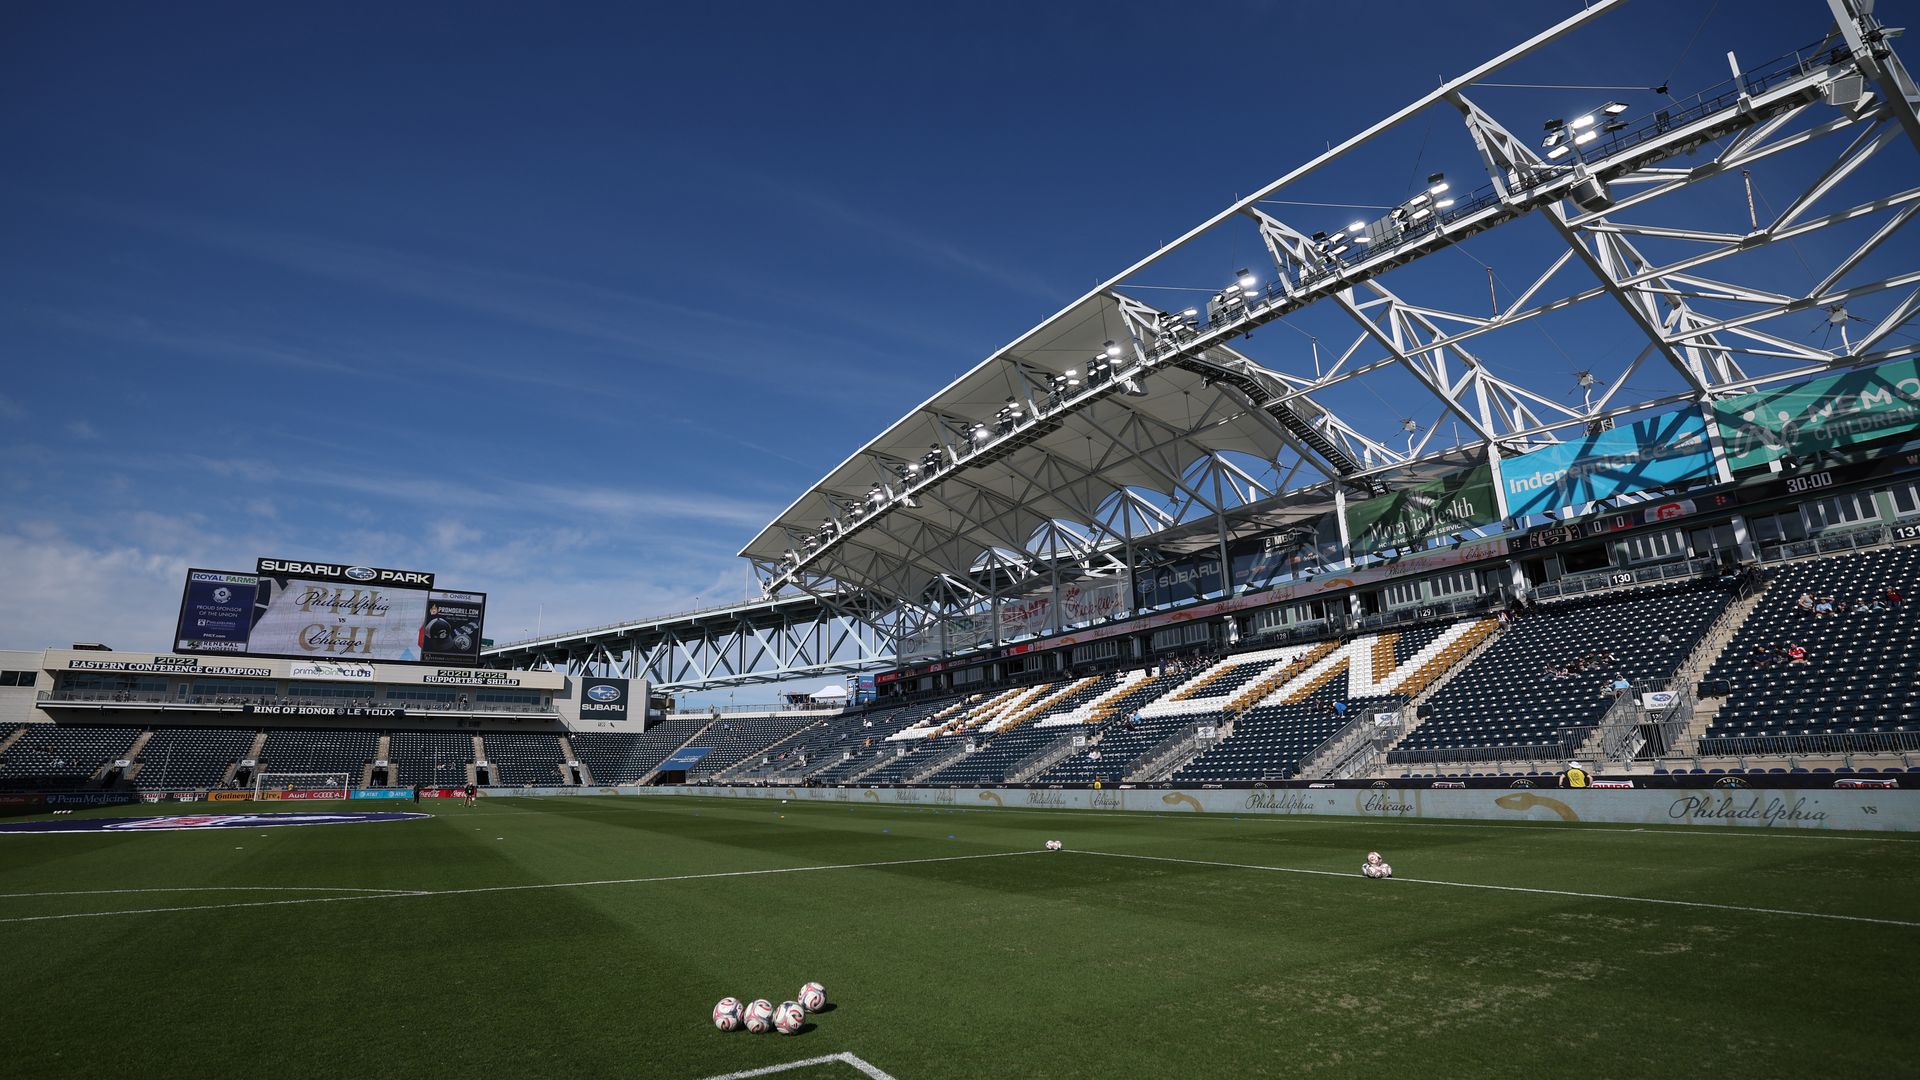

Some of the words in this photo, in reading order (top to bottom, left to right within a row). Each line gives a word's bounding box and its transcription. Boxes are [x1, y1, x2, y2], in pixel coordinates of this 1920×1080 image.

[1786, 471, 1833, 493] 30:00
[1593, 520, 1602, 533] 0
[1616, 516, 1625, 528] 0
[193, 573, 224, 581] ROYAL
[226, 576, 257, 584] FARMS
[260, 560, 341, 576] SUBARU
[381, 571, 432, 585] PARK
[1160, 562, 1220, 588] SUBARU
[1612, 573, 1631, 584] 130
[295, 591, 391, 614] Philadelphia
[308, 630, 365, 655] Chicago
[157, 657, 196, 665] 2022
[71, 660, 127, 670] EASTERN
[128, 663, 203, 673] CONFERENCE
[205, 666, 270, 676] CHAMPIONS
[342, 669, 372, 677] CLUB
[425, 675, 486, 684] SUPPORTERS'
[253, 706, 280, 714] RING
[282, 706, 297, 714] OF
[298, 706, 335, 715] HONOR
[581, 703, 625, 711] SUBARU
[1245, 794, 1315, 814] Philadelphia
[1364, 794, 1415, 817] Chicago
[1669, 796, 1829, 827] Philadelphia
